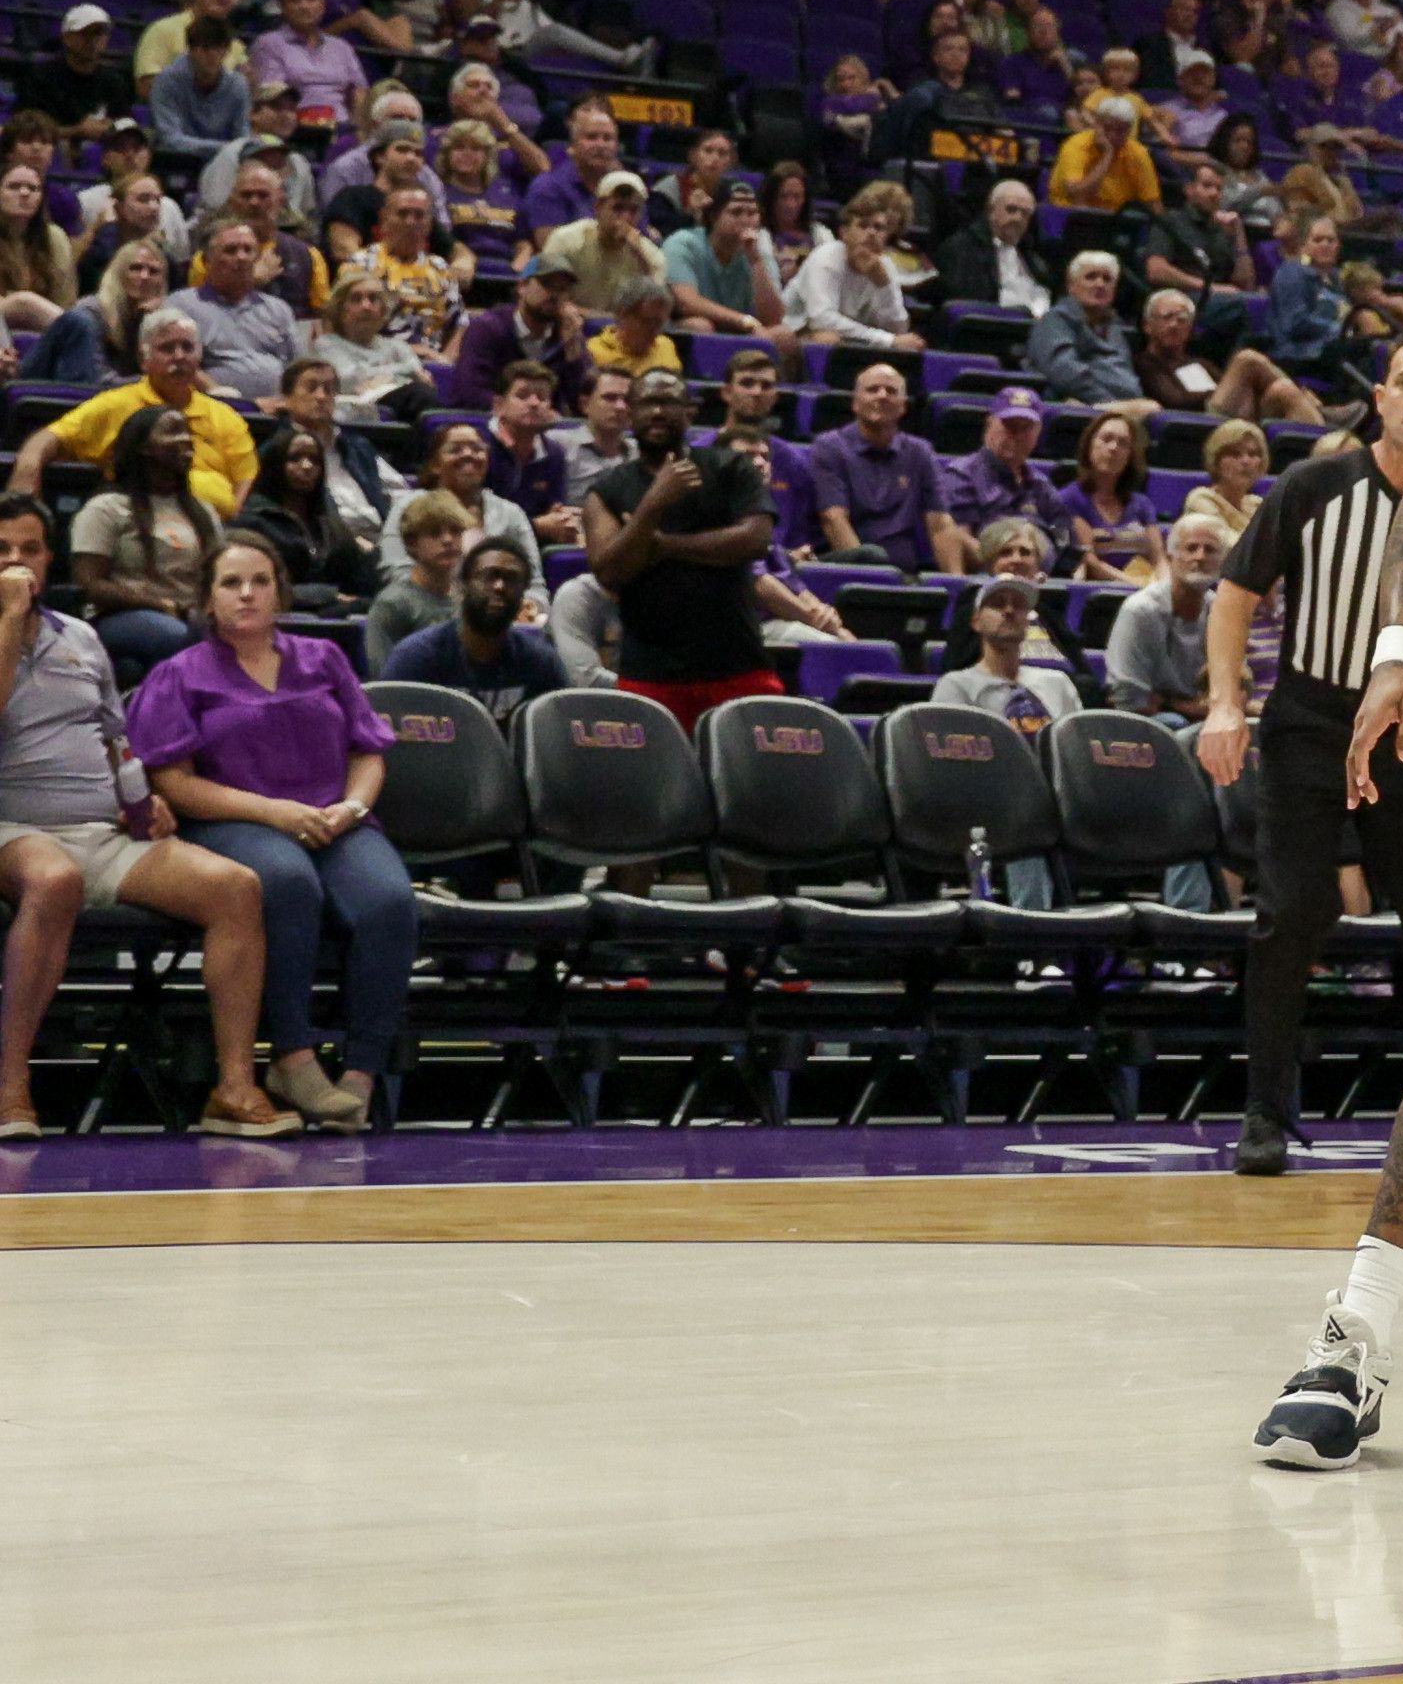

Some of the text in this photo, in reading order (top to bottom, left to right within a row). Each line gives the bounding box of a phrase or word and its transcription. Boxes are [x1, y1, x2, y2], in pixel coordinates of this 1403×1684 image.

[569, 719, 646, 749] LSU
[753, 724, 825, 755] LSU
[925, 731, 995, 762] LSU
[1090, 739, 1157, 769] LSU
